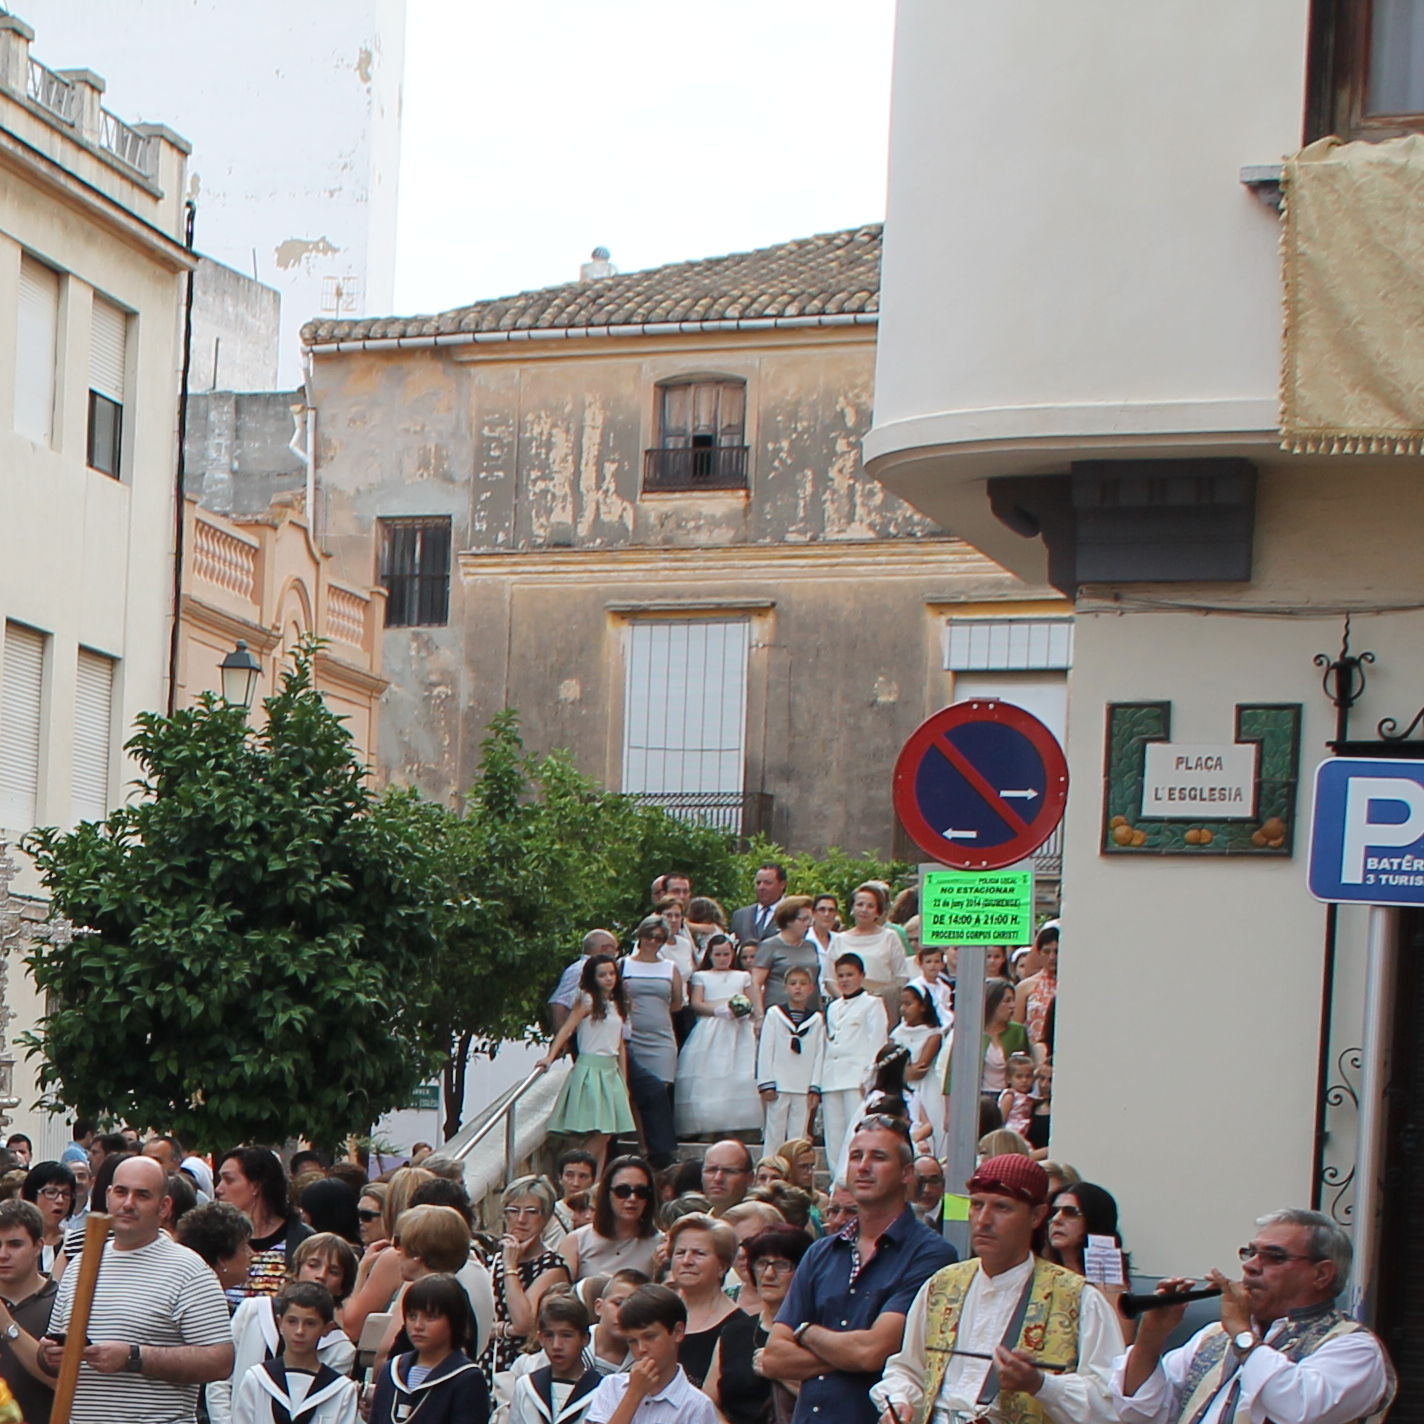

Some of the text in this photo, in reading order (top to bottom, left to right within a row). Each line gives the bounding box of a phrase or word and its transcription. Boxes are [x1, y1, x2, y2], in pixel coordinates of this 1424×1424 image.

[1175, 755, 1223, 773] PLAÇA
[1340, 776, 1424, 884] P
[1366, 874, 1376, 885] 3
[940, 886, 1016, 894] NO ESTACIONAR
[932, 914, 946, 925] DE
[948, 914, 972, 925] 14:00
[973, 914, 981, 925] A
[983, 914, 1009, 925] 21:00
